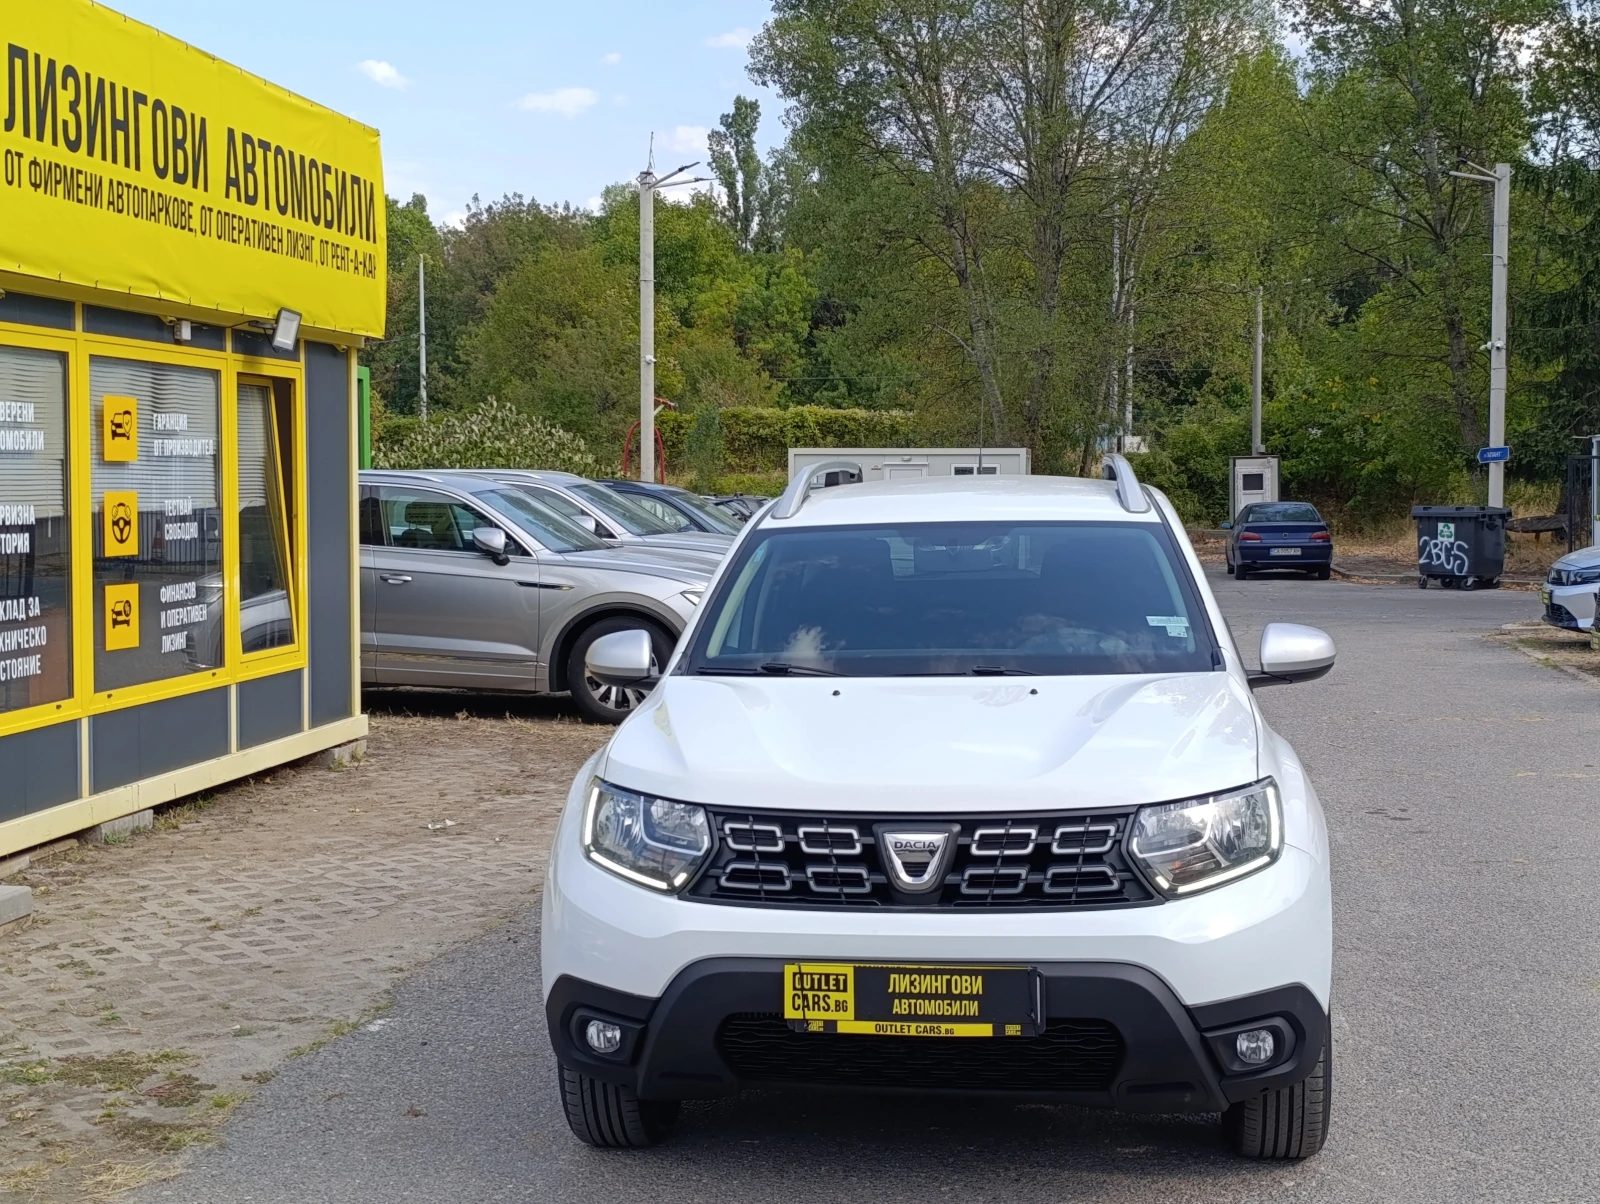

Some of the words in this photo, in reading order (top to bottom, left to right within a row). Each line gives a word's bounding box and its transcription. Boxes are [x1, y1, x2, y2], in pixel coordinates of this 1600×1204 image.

[4, 42, 209, 193] ЛИЗИНГОВИ
[224, 126, 377, 245] АВТОМОБИЛИ
[4, 148, 24, 189] ОТ
[28, 156, 103, 210] ФИРМЕНИ
[107, 177, 197, 238] АВТОПАРКОВЕ,
[200, 204, 214, 238] ОТ
[216, 209, 284, 256] ОПЕРАТИВЕН
[319, 238, 330, 267] ОТ
[153, 413, 188, 432] ГАРАНЦИЯ
[154, 439, 163, 456] ОТ
[164, 495, 193, 517] ТЕСТВАЙ
[164, 521, 199, 541] СВОБОДНО
[160, 581, 197, 604] ФИНАНСОВ
[28, 596, 41, 618] ЗА
[160, 610, 167, 629] И
[166, 603, 208, 628] ОПЕРАТИВЕН
[161, 631, 188, 654] ЛИЗИНГ
[894, 841, 937, 849] DACIA
[794, 974, 846, 991] OUTLET
[888, 973, 983, 995] ЛИЗИНГОВИ
[791, 993, 849, 1013] CARS.BG
[892, 998, 979, 1017] АВТОМОБИЛИ
[874, 1023, 912, 1034] OUTLET
[915, 1025, 955, 1035] CARS.BG
